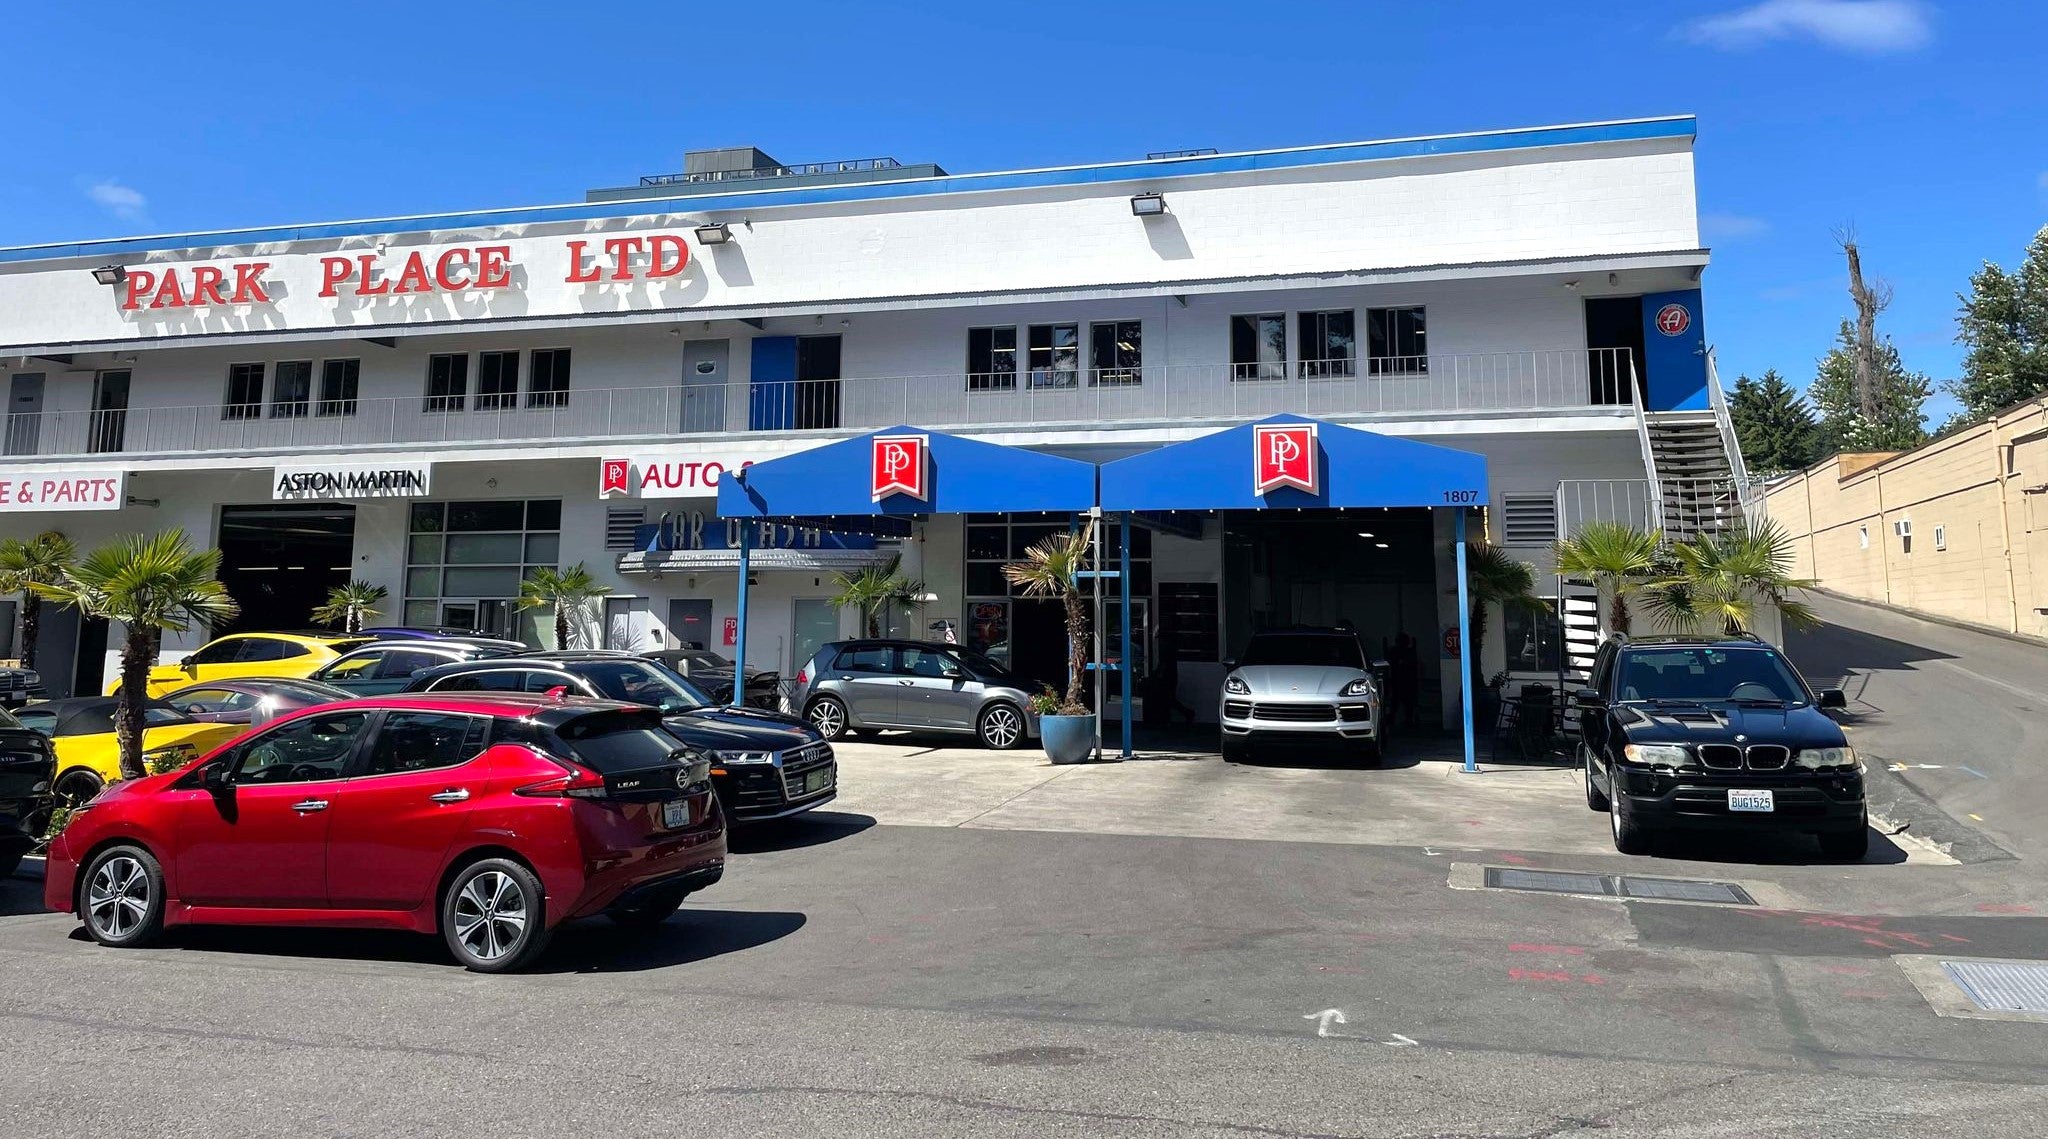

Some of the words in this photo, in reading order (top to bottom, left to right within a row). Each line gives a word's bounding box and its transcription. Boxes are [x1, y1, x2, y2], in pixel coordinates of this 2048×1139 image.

[122, 263, 271, 310] PARK
[318, 245, 511, 298] PLACE
[565, 235, 690, 283] LTD
[277, 471, 343, 491] ASTON
[347, 470, 422, 489] MARTIN
[640, 461, 724, 489] AUTO
[17, 481, 33, 503] &
[41, 479, 117, 503] PARTS
[1443, 490, 1479, 503] 1807
[659, 510, 704, 550] CAR
[1445, 636, 1458, 648] ST
[617, 780, 640, 788] LEAF
[1731, 796, 1771, 808] BUG1525
